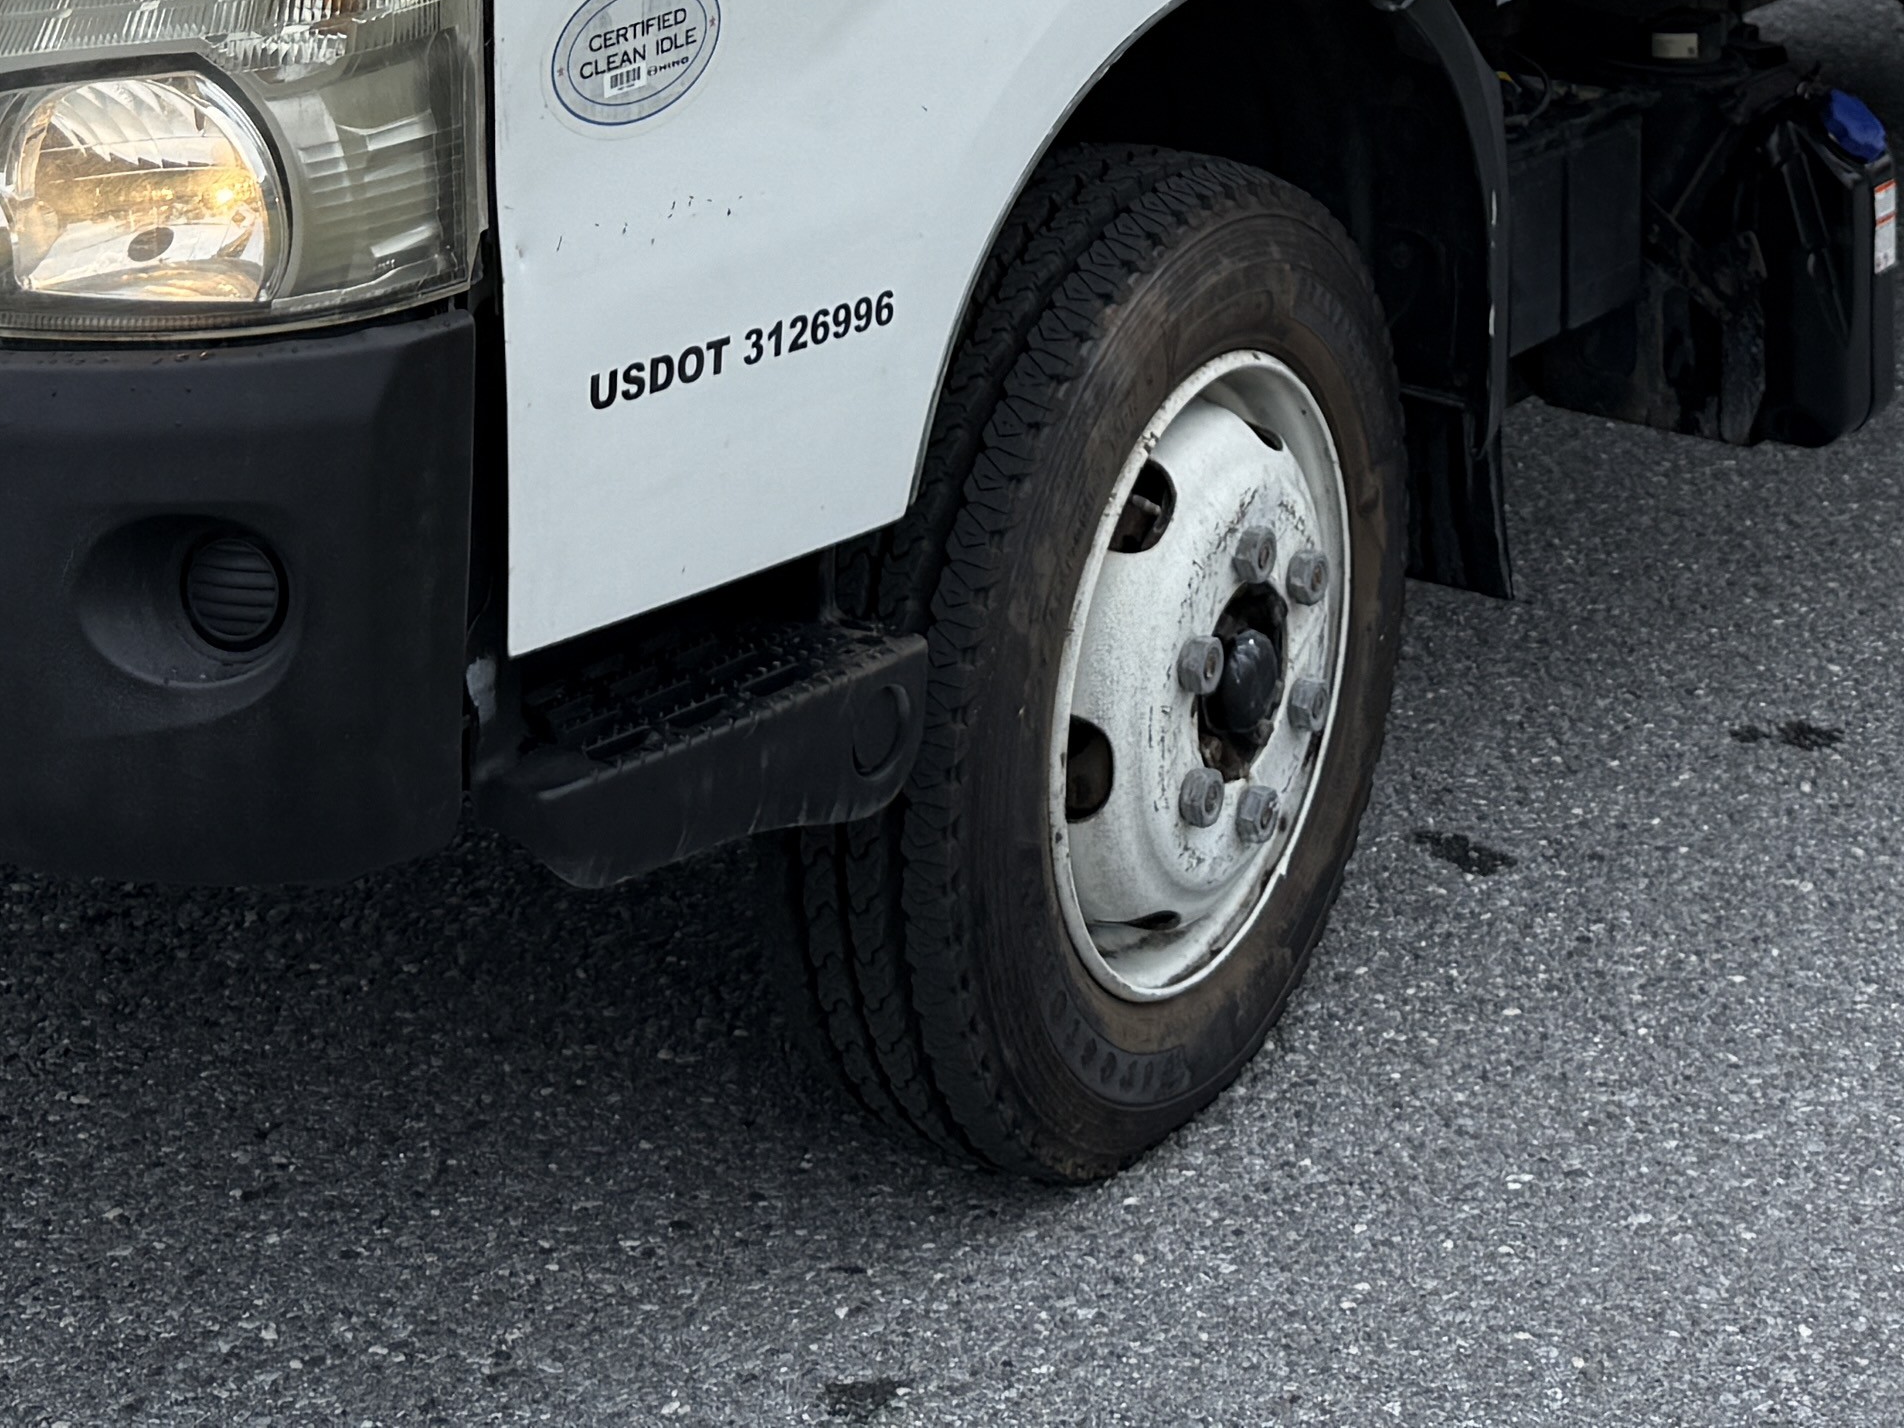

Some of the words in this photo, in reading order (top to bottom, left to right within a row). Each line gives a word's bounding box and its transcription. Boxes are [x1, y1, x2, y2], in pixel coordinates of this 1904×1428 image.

[580, 44, 646, 80] CLEAN
[656, 27, 697, 56] IDLE
[588, 8, 687, 52] CERTIFIED
[659, 56, 690, 71] HINO
[589, 335, 731, 410] USDOT
[743, 290, 895, 365] 3126996
